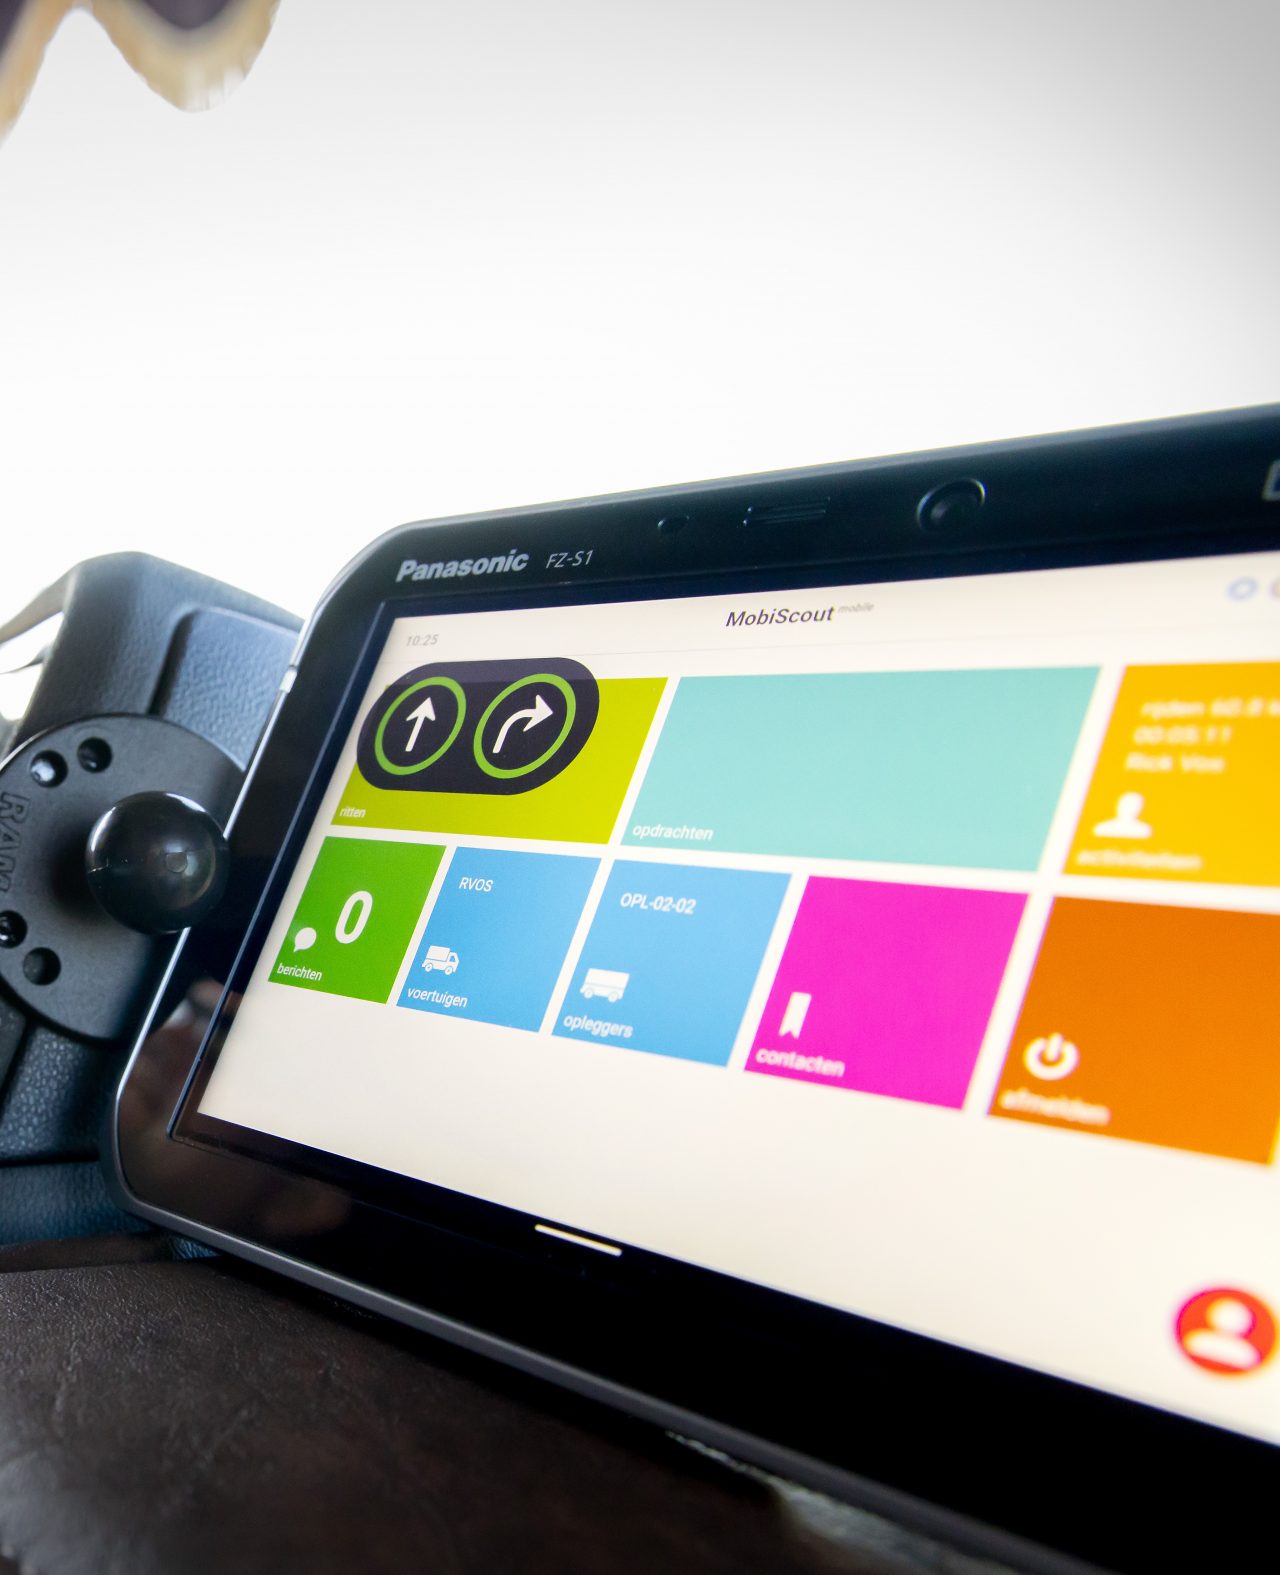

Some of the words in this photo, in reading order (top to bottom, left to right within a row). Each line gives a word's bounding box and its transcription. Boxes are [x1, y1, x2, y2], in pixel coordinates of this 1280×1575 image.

[396, 549, 529, 583] Panasonic
[545, 549, 594, 569] FZ-S1
[725, 606, 835, 627] MobiScout
[339, 806, 366, 819] ritten
[632, 823, 714, 842] opdrachten
[458, 876, 494, 893] RVOS
[620, 891, 697, 916] OPL-02-02
[335, 890, 373, 944] 0
[277, 962, 323, 982] berichten
[407, 986, 468, 1009] voertuigen
[563, 1013, 633, 1040] opleggers
[756, 1048, 846, 1078] contacten
